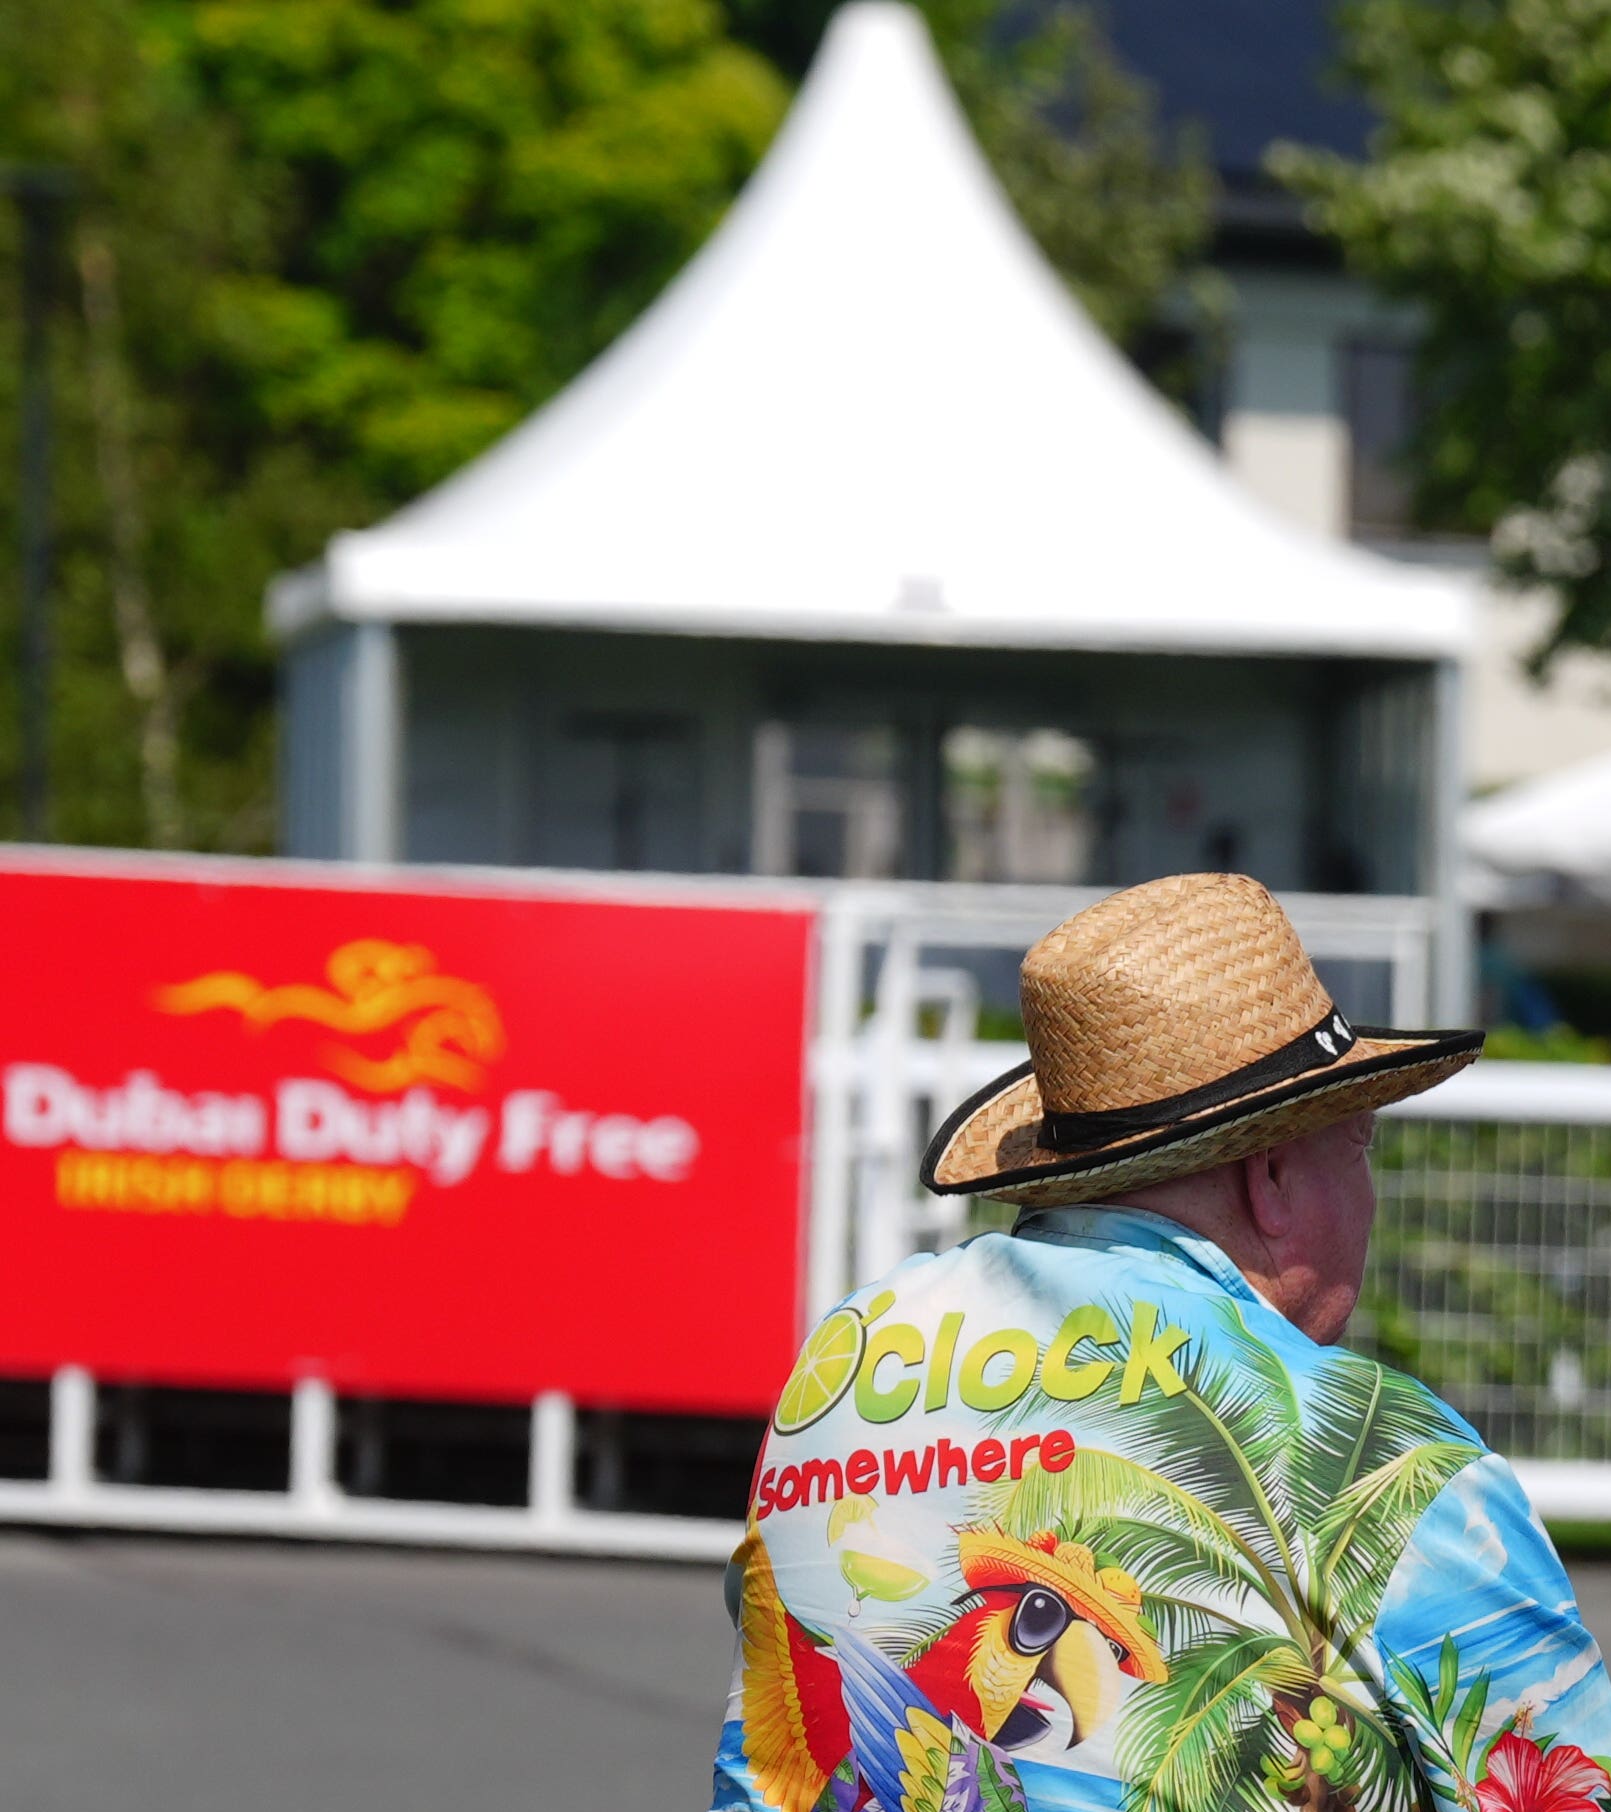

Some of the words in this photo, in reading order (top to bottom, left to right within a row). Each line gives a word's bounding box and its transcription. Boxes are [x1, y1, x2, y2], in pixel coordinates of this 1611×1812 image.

[4, 1062, 267, 1156] Dubai
[275, 1077, 488, 1187] Duty
[497, 1090, 700, 1182] Free
[756, 1429, 1076, 1520] somewhere
